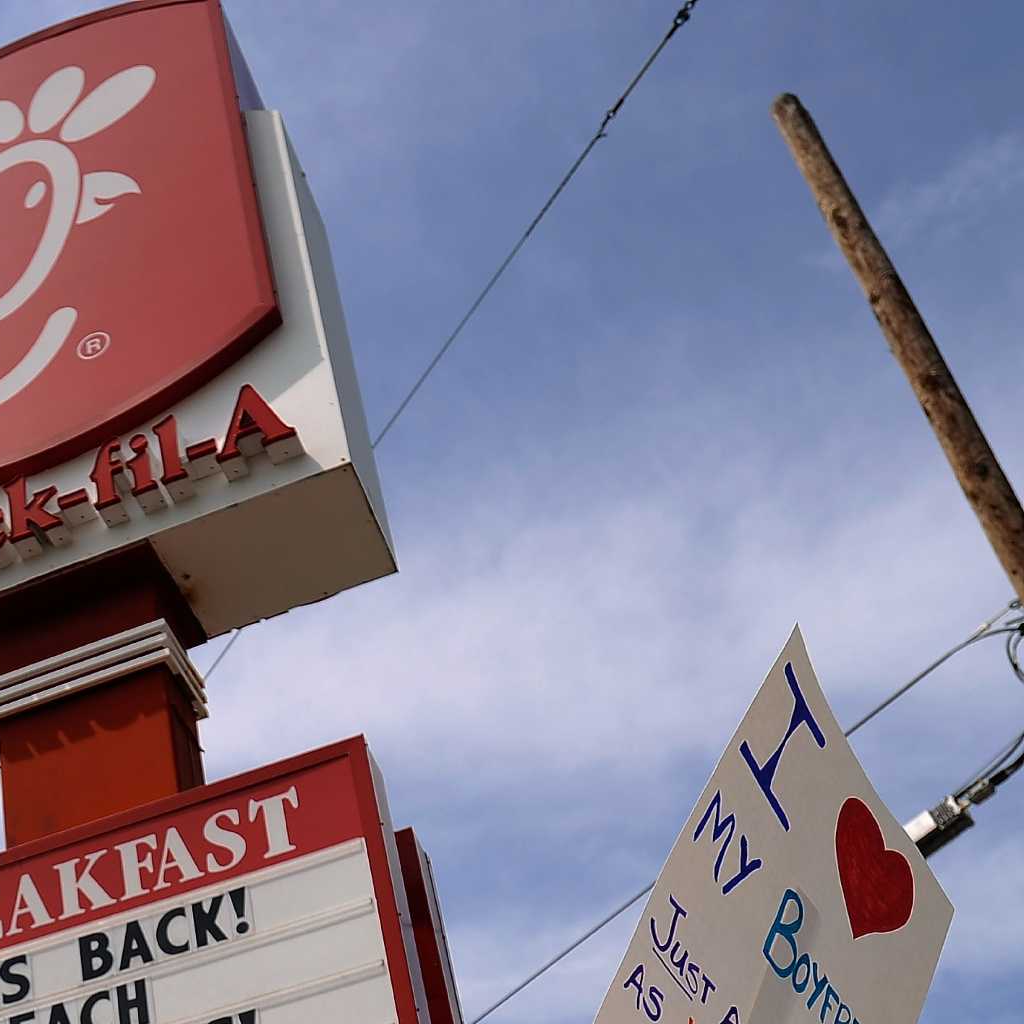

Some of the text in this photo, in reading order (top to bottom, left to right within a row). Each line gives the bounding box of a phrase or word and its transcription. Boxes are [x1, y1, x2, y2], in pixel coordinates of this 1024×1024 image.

[692, 789, 762, 895] MY
[78, 886, 252, 981] BACK!
[623, 964, 664, 1022] AS
